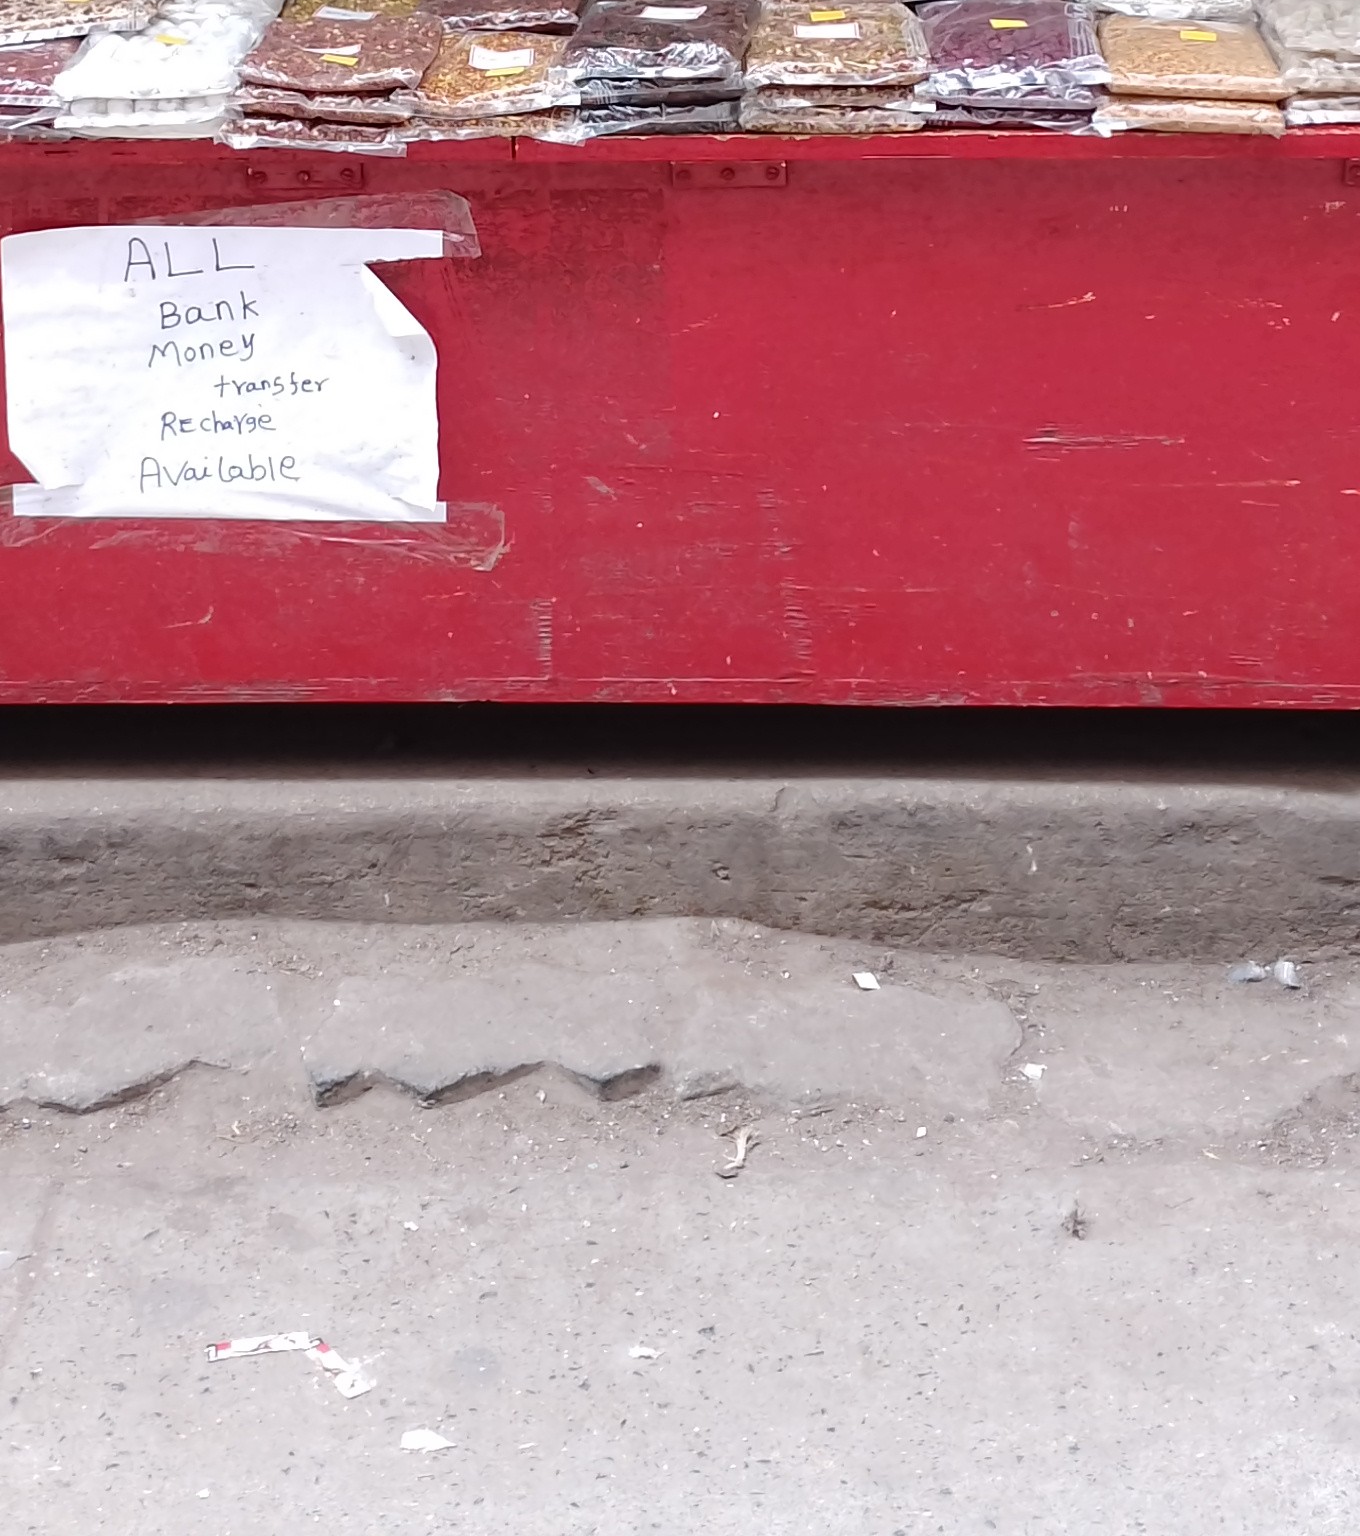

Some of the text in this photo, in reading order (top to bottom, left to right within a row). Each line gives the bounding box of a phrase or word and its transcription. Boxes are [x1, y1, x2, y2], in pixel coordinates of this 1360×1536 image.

[125, 237, 255, 282] ALL
[159, 291, 260, 330] Bank
[148, 332, 256, 369] Money
[213, 375, 330, 399] transfer
[140, 455, 302, 494] Available
